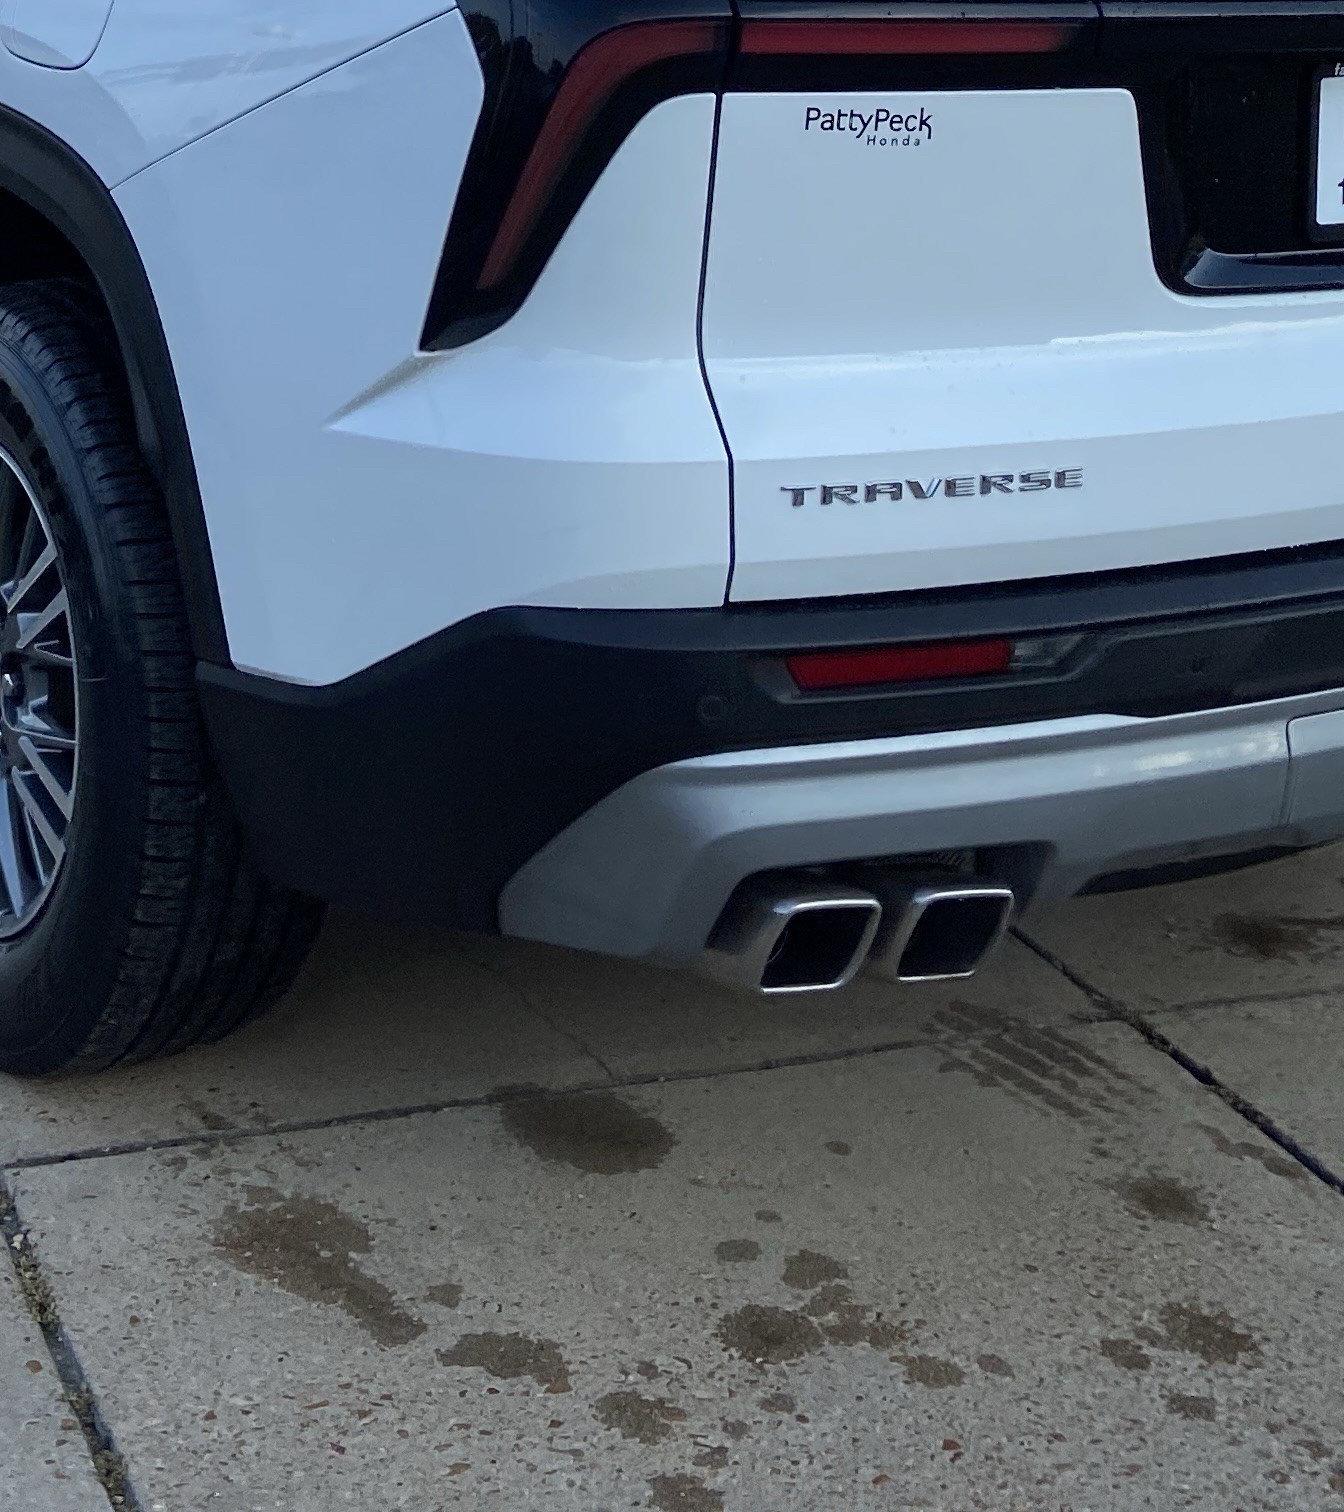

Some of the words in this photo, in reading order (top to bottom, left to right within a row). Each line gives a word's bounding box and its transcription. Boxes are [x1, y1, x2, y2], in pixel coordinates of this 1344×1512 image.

[805, 107, 934, 140] PattyPeck
[866, 134, 921, 147] Honda
[780, 467, 1085, 508] TRAVERSE
